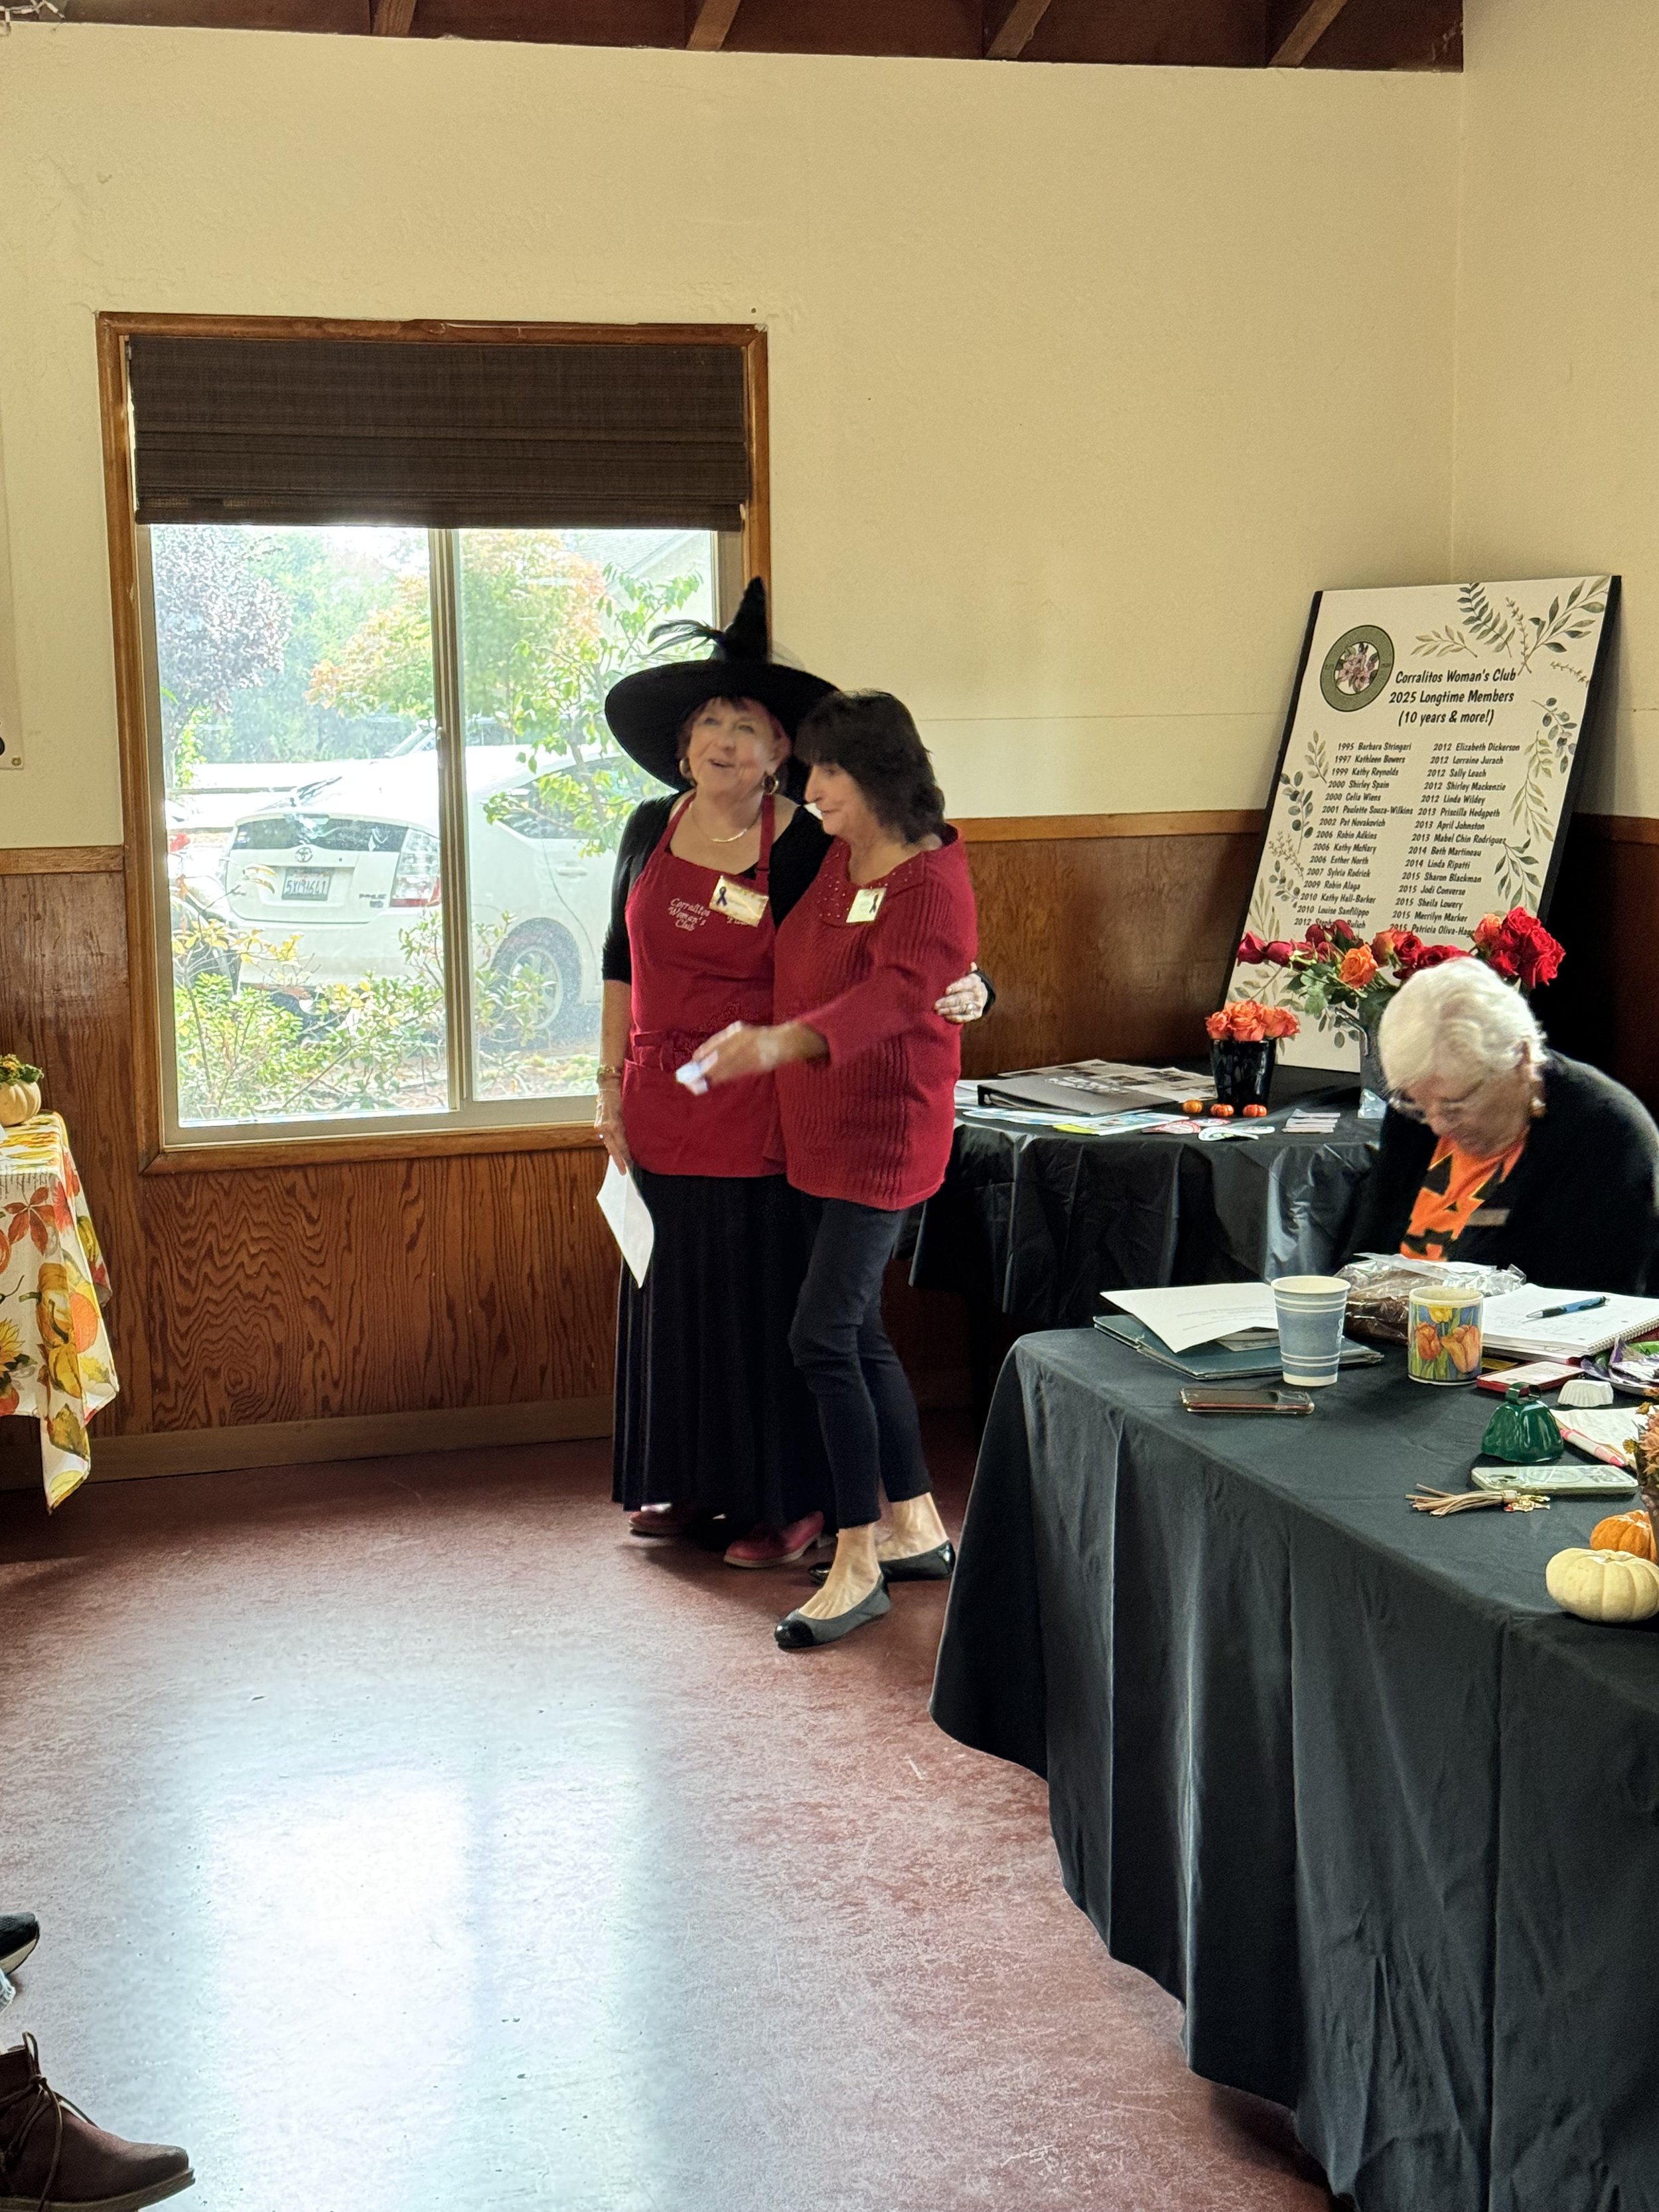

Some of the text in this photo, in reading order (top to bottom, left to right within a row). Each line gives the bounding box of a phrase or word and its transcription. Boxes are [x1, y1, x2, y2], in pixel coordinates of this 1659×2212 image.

[1396, 668, 1516, 684] Corralitos Woman's Club
[1389, 689, 1514, 706] 2025 Longtime Members
[1398, 709, 1494, 727] (10 years & more!)
[1384, 743, 1412, 753] Stringari
[1456, 743, 1486, 751] Elizabeth
[1488, 743, 1520, 751] Dickerson
[1355, 755, 1381, 763] Kathleen
[1352, 767, 1370, 778] Kathy
[1371, 767, 1399, 778] Reynolds
[1449, 769, 1467, 779] Sally
[1468, 769, 1486, 777] Leach
[1348, 780, 1370, 790] Shirley
[1372, 780, 1389, 790] Spain
[1446, 782, 1470, 792] Shirley
[1471, 782, 1506, 791] Mackenzie
[1345, 792, 1360, 801] Celia
[1443, 794, 1461, 803] Linda
[1463, 795, 1485, 806] Wildey
[1342, 805, 1367, 814] Paulette
[1369, 806, 1413, 814] Souza-Wilkins
[1440, 808, 1467, 816] Priscilla
[1469, 808, 1500, 820] Hedgpeth
[1352, 818, 1386, 827] Novakovich
[1414, 820, 1485, 831] 2013 April Johnston
[1336, 830, 1354, 839] Robin
[1355, 831, 1377, 840] Adkins
[1433, 834, 1455, 842] Mabel
[1455, 834, 1471, 843] Chin
[1473, 834, 1506, 846] Rodriguez
[1333, 843, 1351, 853] Kathy
[1431, 846, 1446, 855] Beth
[1448, 847, 1481, 857] Martineau
[1331, 855, 1350, 864] Esther
[1427, 859, 1445, 868] Linda
[1447, 859, 1471, 871] Ripatti
[1327, 868, 1345, 879] Sylvia
[1347, 869, 1371, 877] Rodrick
[1424, 872, 1447, 881] Sharon
[1449, 873, 1482, 883] Blackman
[1324, 881, 1342, 889] Robin
[1342, 881, 1360, 892] Alaga
[1420, 885, 1435, 894] Jodi
[1436, 886, 1466, 895] Converse
[1321, 893, 1338, 904] Kathy
[1340, 893, 1376, 904] Hall-Barker
[1417, 898, 1437, 907] Sheila
[1440, 899, 1463, 911] Lowery
[1317, 905, 1336, 915] Louise
[1338, 907, 1370, 918] Sanfilippo
[1414, 911, 1442, 923] Merrilyn
[1443, 913, 1468, 922] Marker
[1411, 924, 1436, 934] Patricia
[1438, 925, 1474, 938] Oliva-Hag
